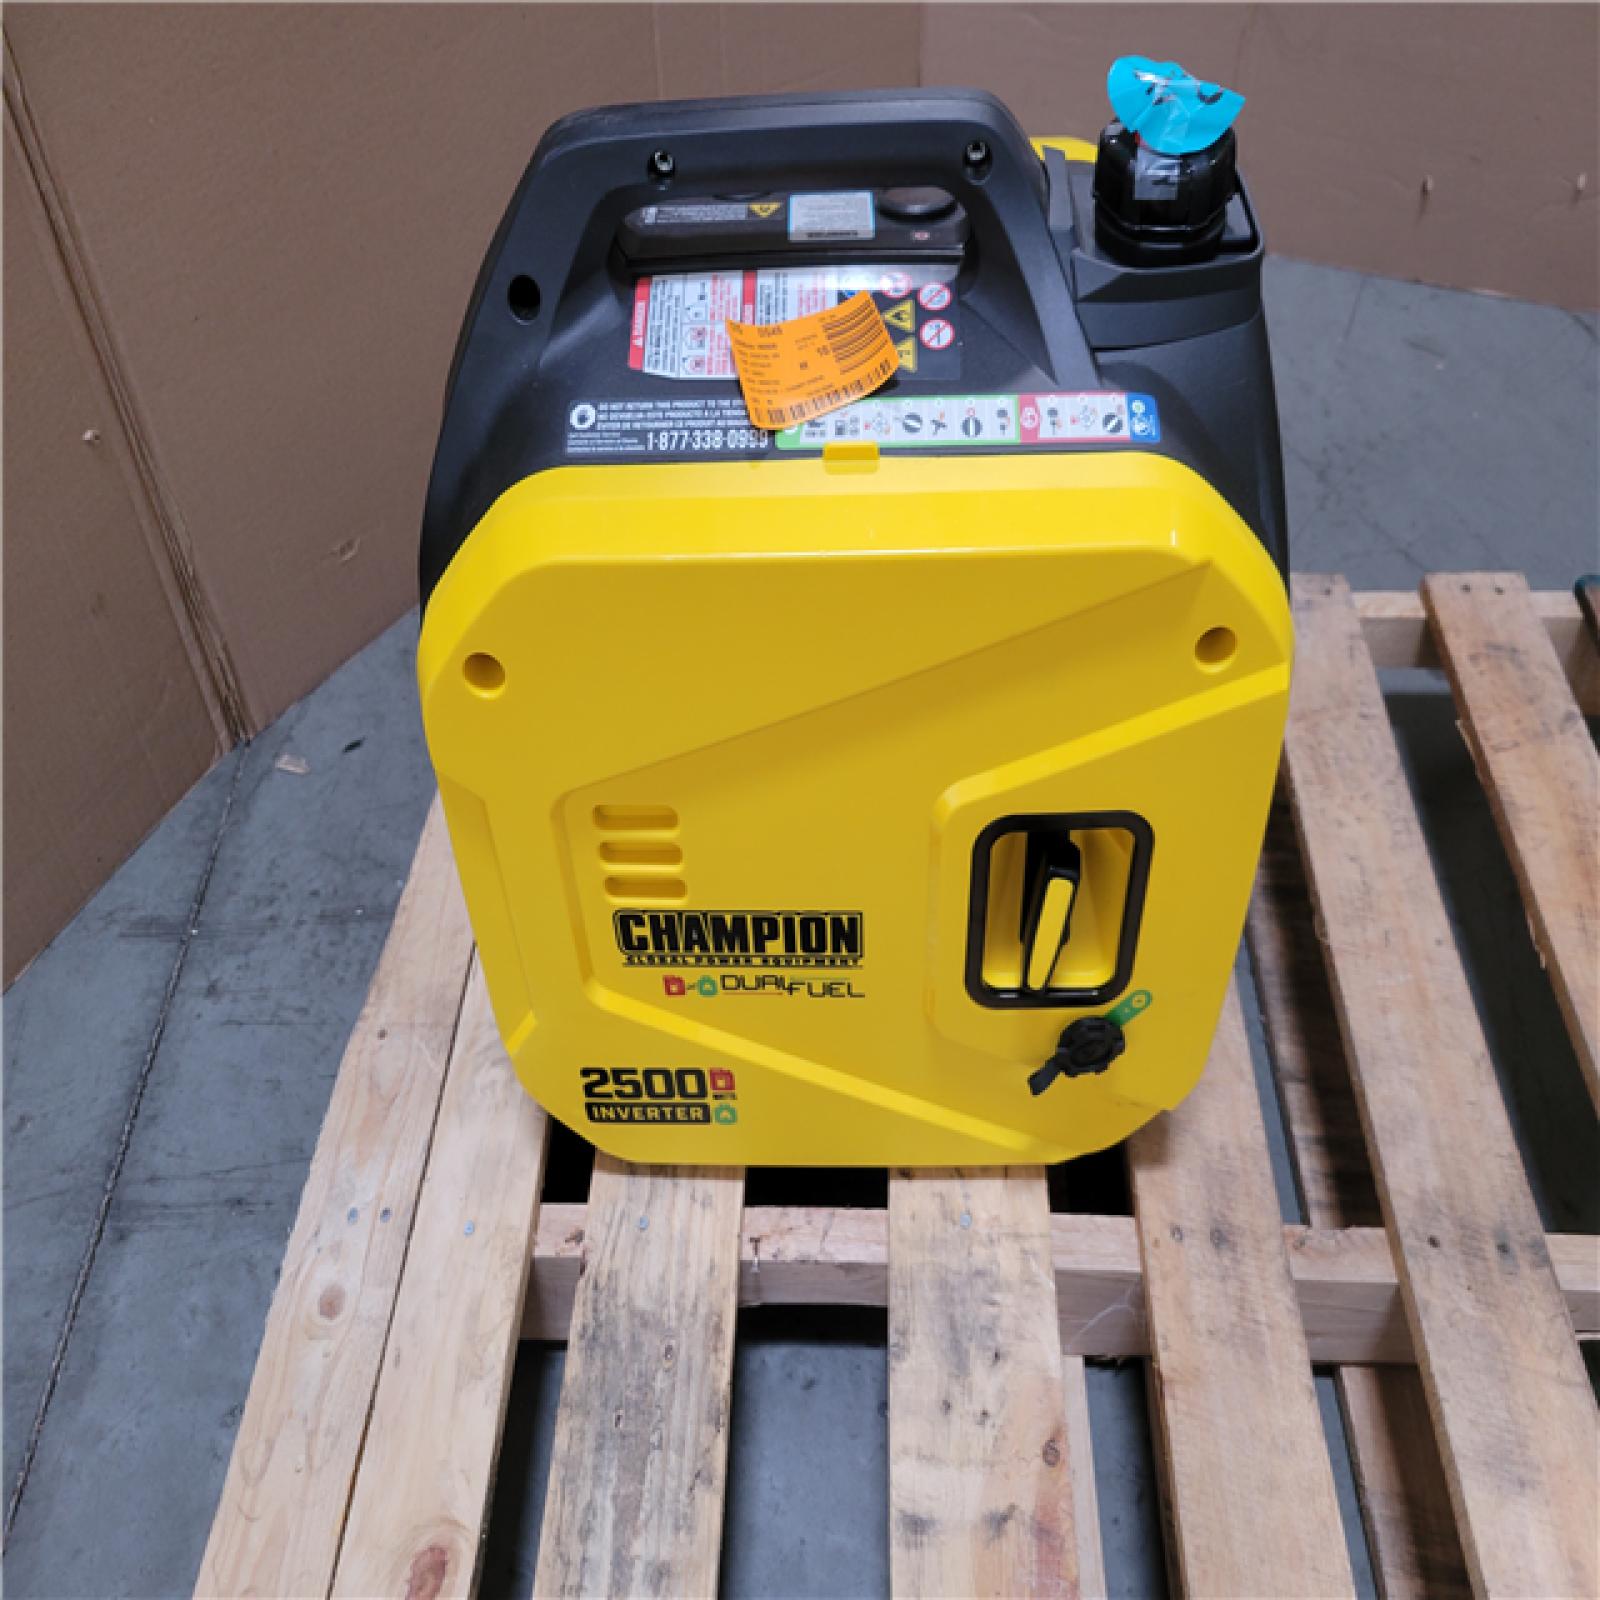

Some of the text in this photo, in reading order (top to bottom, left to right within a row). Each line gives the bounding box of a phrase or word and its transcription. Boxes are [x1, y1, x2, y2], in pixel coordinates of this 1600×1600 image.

[616, 912, 861, 955] CHAMPION
[625, 955, 860, 965] GLOBAL POWER EQUIPMENT
[787, 981, 866, 998] FUEL
[580, 1067, 708, 1099] 2500
[591, 1105, 705, 1121] INVERTER
